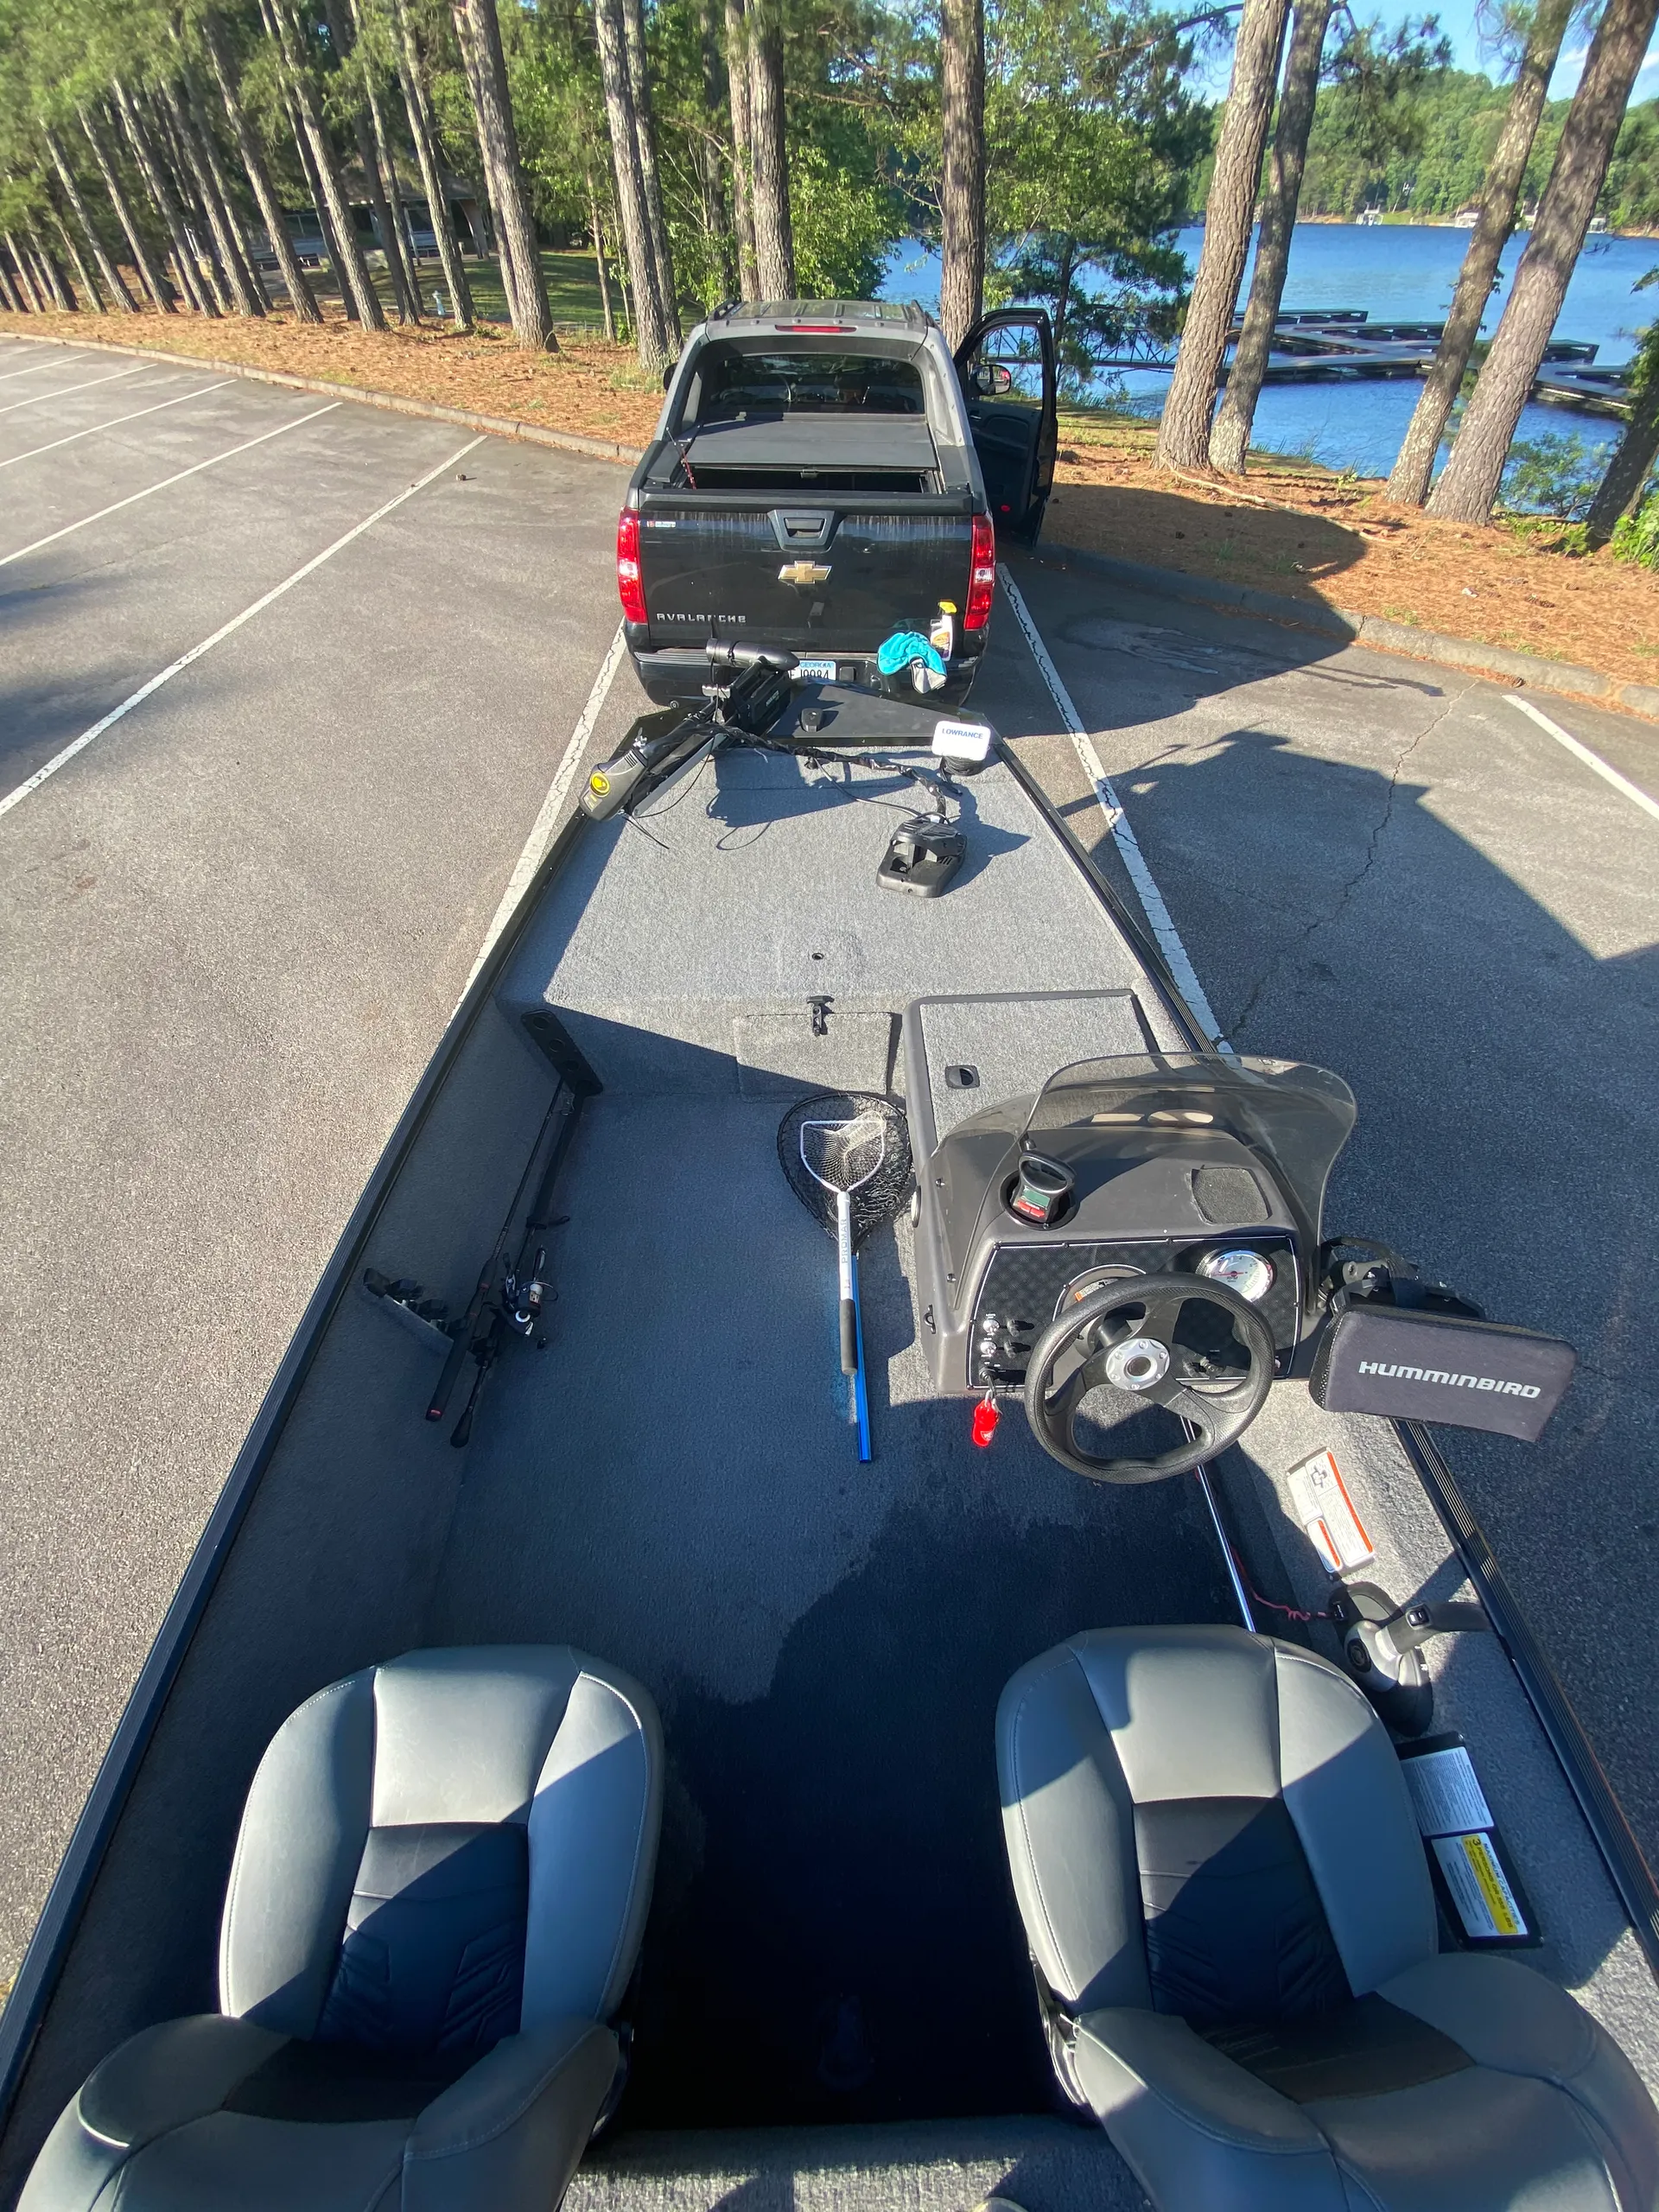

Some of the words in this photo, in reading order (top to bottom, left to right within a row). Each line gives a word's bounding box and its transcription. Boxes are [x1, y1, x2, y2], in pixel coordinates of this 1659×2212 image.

[942, 728, 983, 740] LOWRANCE
[840, 1218, 849, 1264] PROMAR
[1358, 1361, 1541, 1399] HUMMINBIRD
[1477, 1847, 1494, 1882] PERSONS
[1484, 1843, 1501, 1878] MAXIMUM
[1498, 1879, 1520, 1925] CAPACITIES
